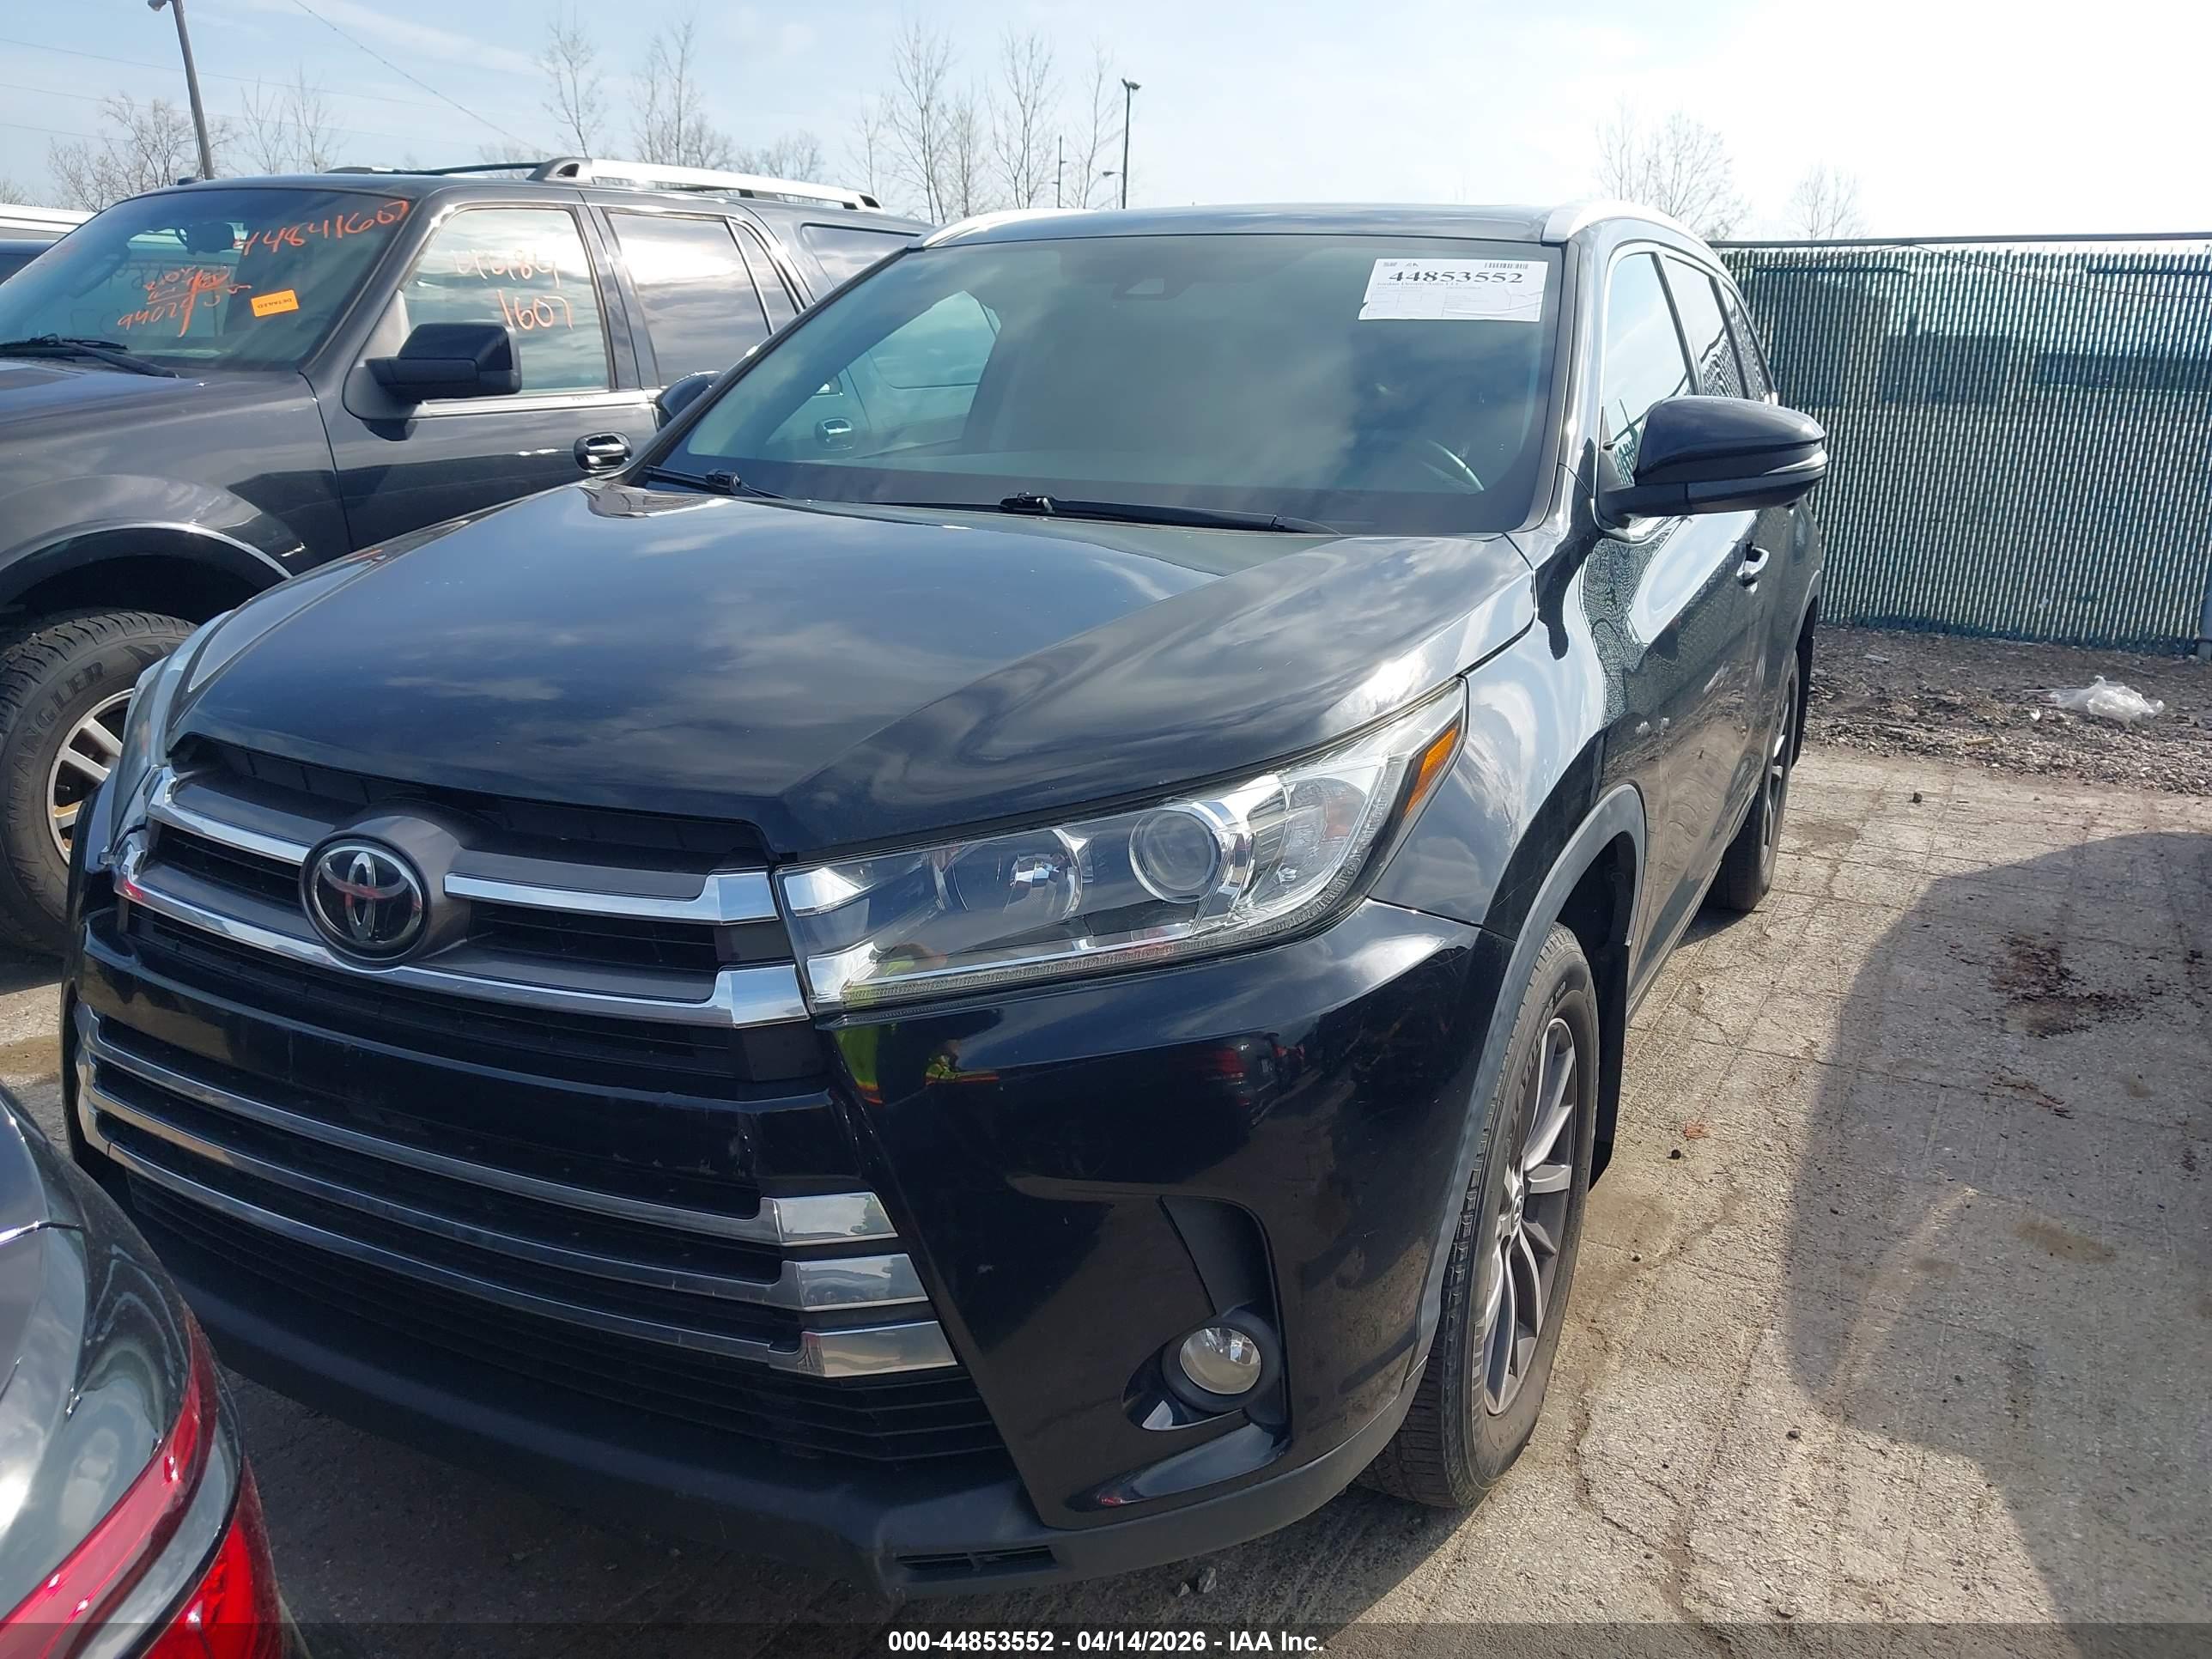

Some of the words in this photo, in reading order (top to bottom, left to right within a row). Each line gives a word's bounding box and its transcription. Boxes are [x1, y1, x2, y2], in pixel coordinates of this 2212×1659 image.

[233, 199, 410, 256] 44841607
[1389, 270, 1524, 283] 44853552
[497, 289, 574, 331] 1607
[7, 661, 105, 831] WRANGLER
